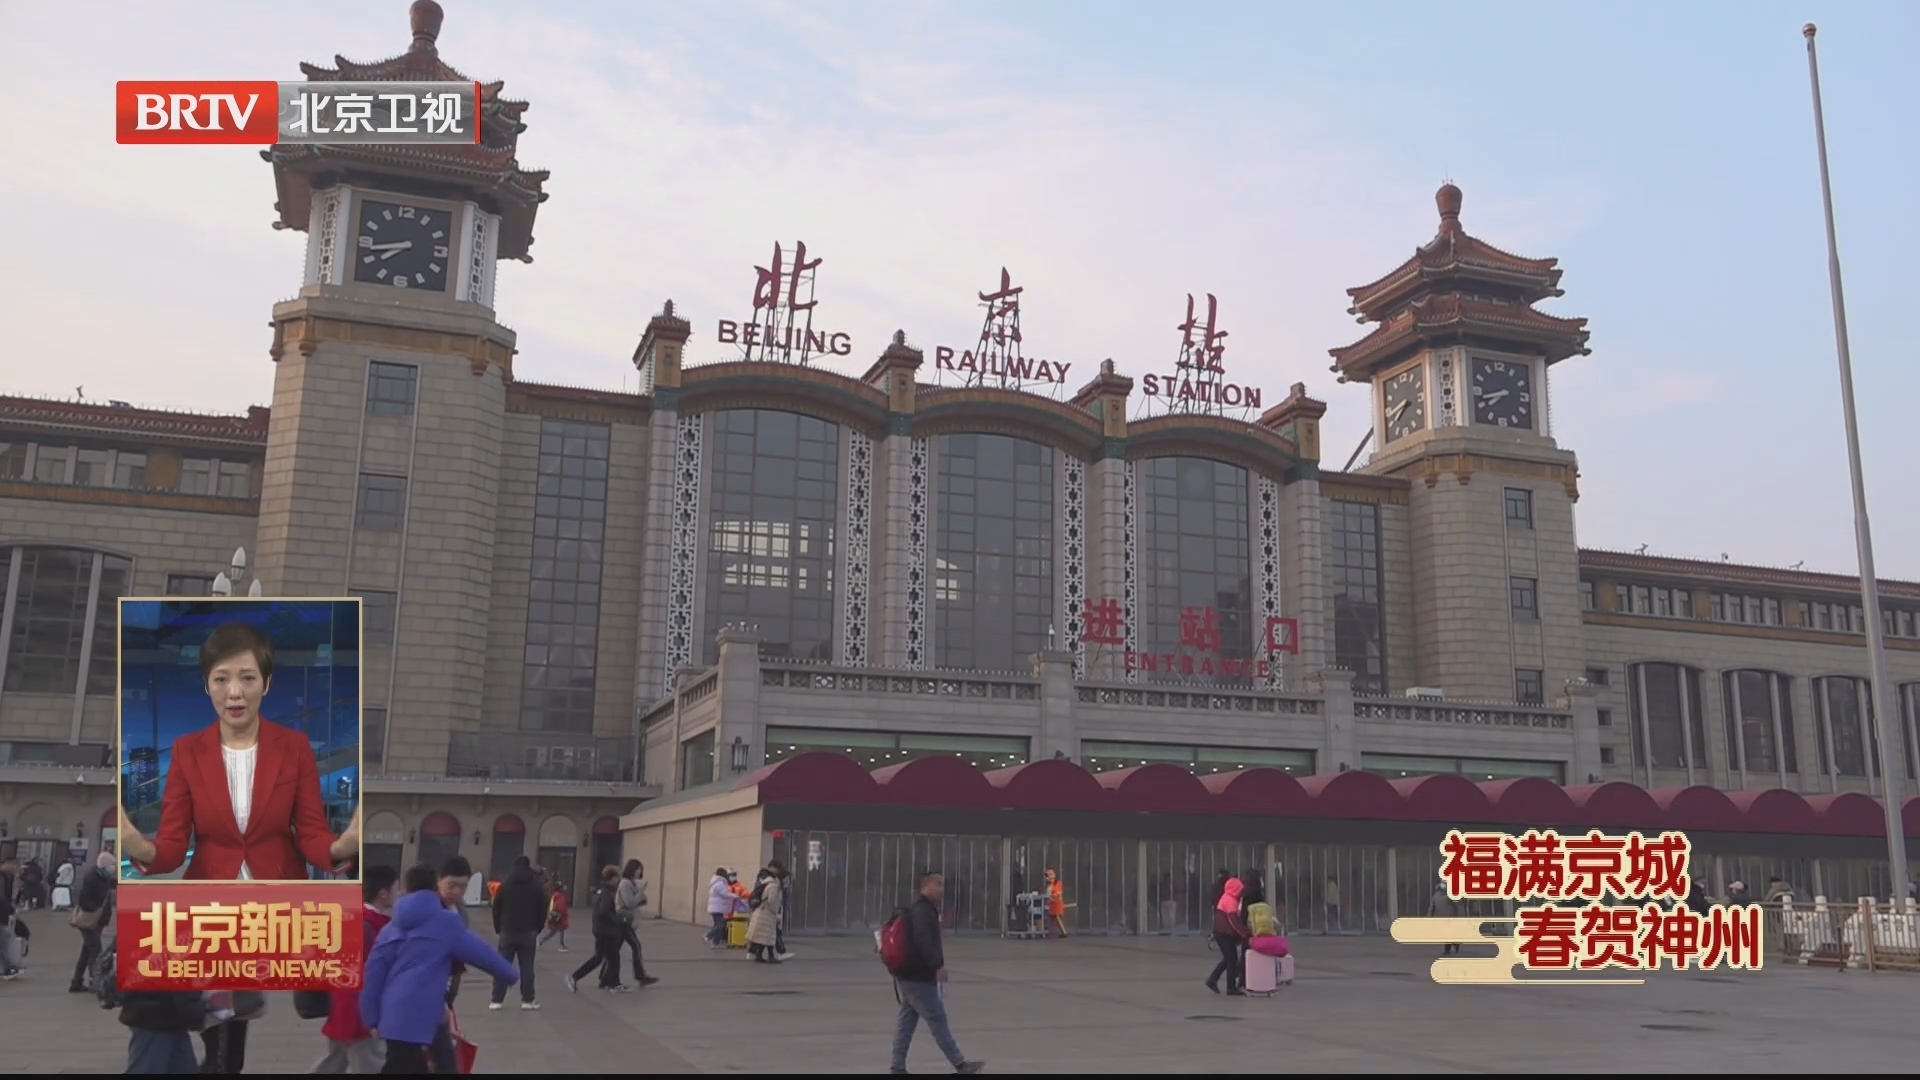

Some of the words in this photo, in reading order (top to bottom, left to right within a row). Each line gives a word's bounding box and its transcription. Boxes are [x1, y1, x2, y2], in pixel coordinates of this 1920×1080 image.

[398, 206, 415, 219] 12
[718, 319, 851, 356] BEIJING
[936, 345, 1072, 384] RAILWAY
[1143, 373, 1261, 409] STATION
[1079, 598, 1299, 656] 进站口
[1123, 652, 1272, 679] ENTRANCE
